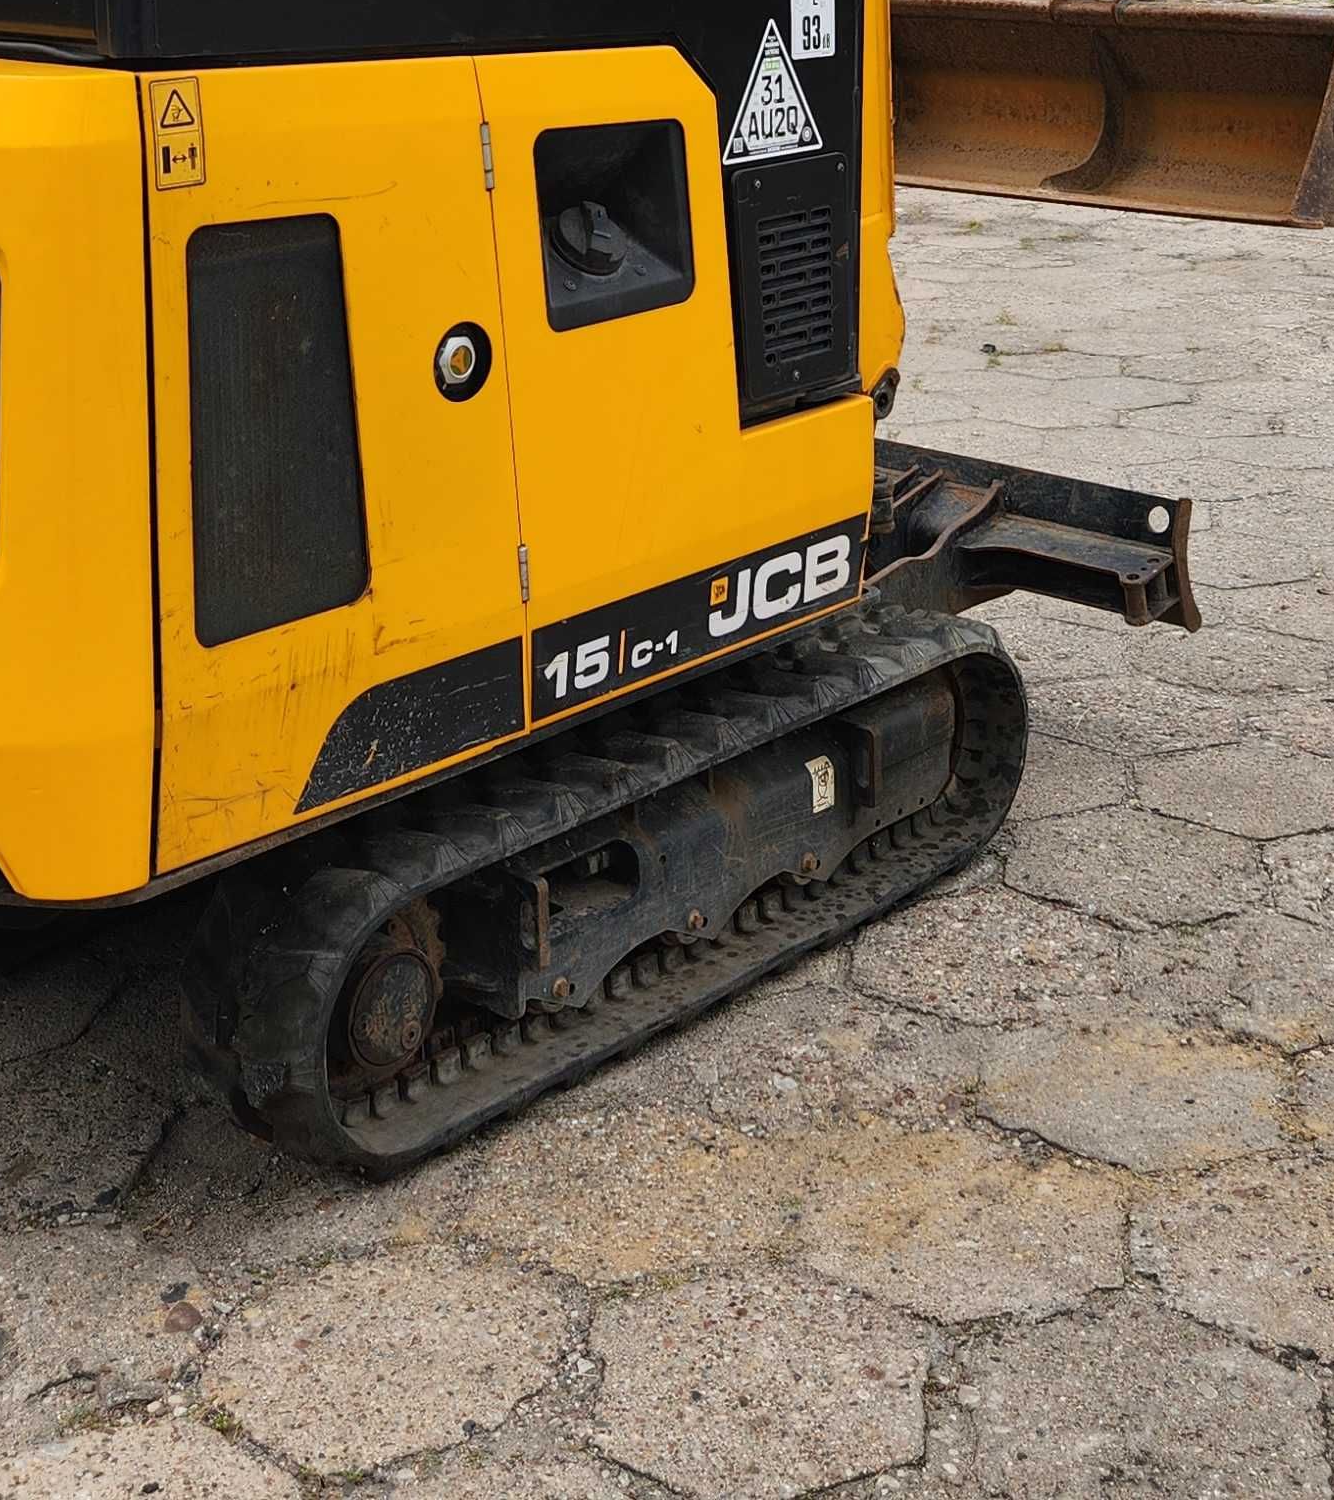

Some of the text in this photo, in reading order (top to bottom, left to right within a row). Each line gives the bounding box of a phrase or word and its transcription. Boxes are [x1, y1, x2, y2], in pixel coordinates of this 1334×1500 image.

[802, 15, 821, 50] 93
[761, 74, 785, 106] 31
[748, 106, 798, 142] AU2Q
[708, 535, 851, 638] JCB
[543, 635, 610, 699] 15
